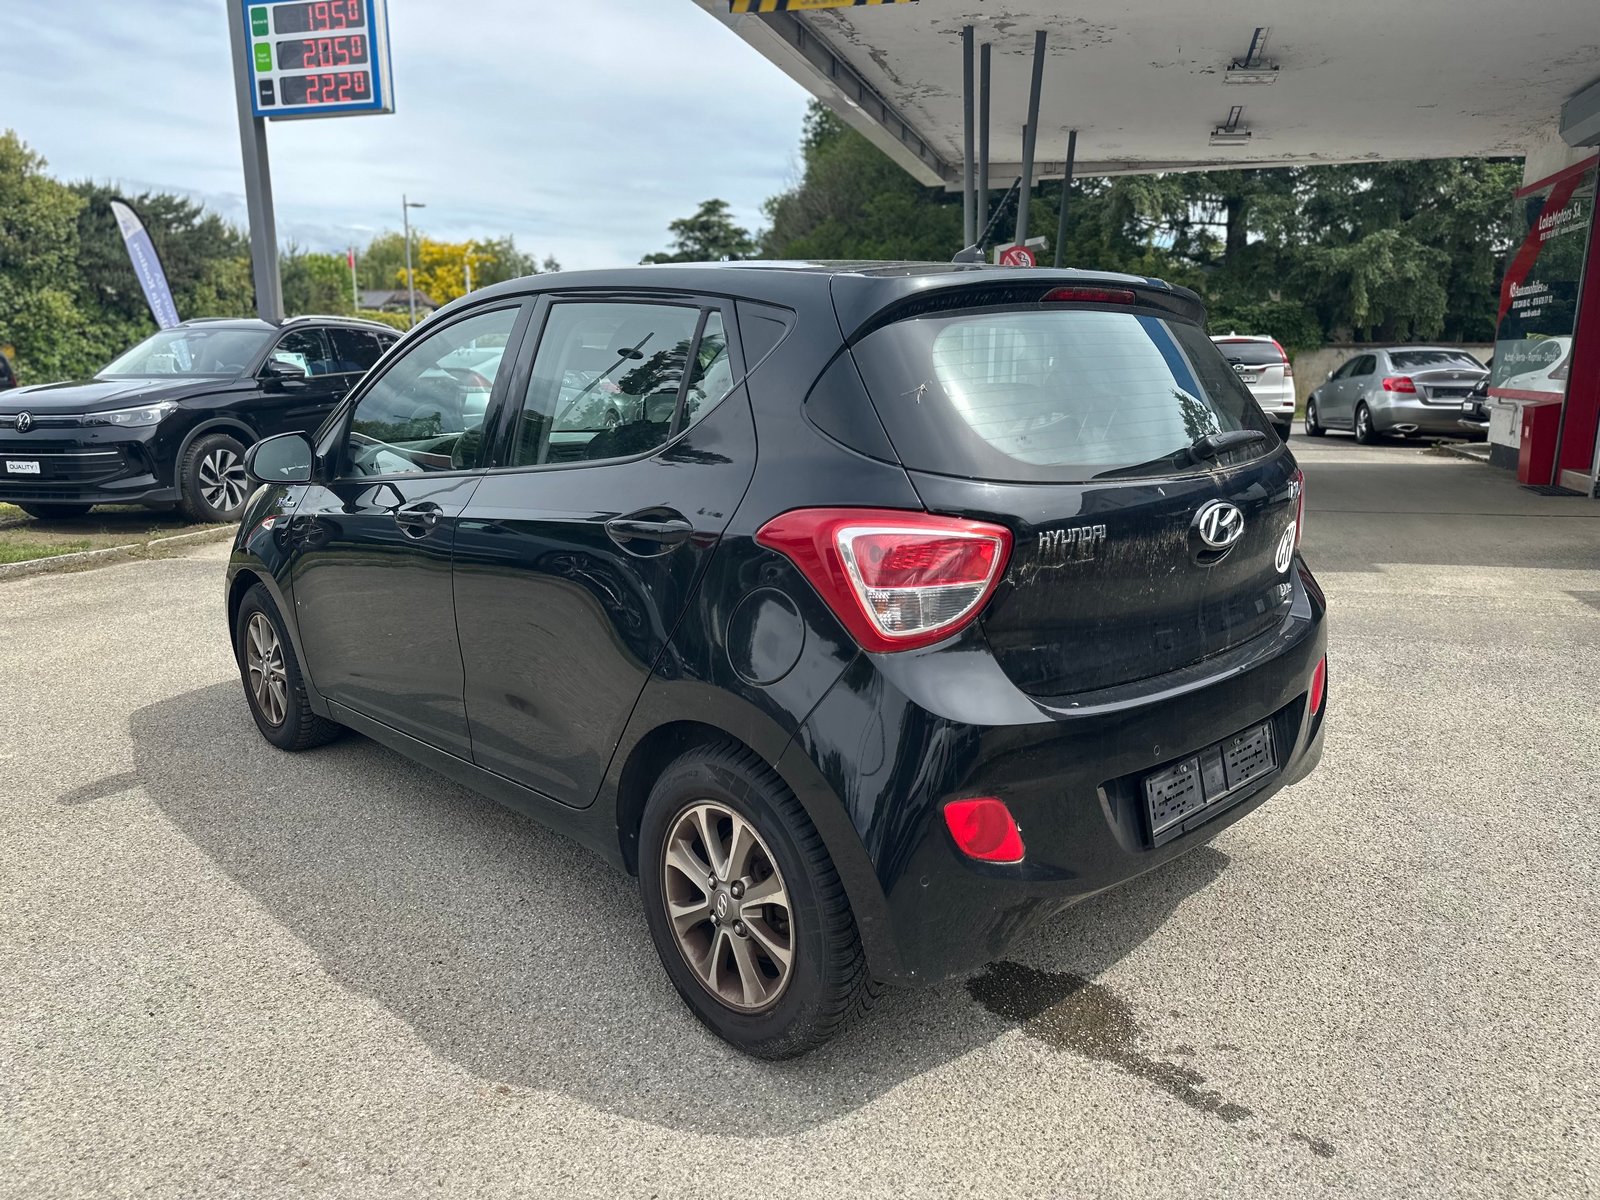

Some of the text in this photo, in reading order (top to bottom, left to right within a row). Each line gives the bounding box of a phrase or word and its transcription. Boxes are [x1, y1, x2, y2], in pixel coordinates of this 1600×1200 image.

[303, 36, 362, 69] 2050
[306, 71, 365, 104] 2220
[1039, 524, 1106, 547] HYUNDAI
[1277, 525, 1296, 569] CH
